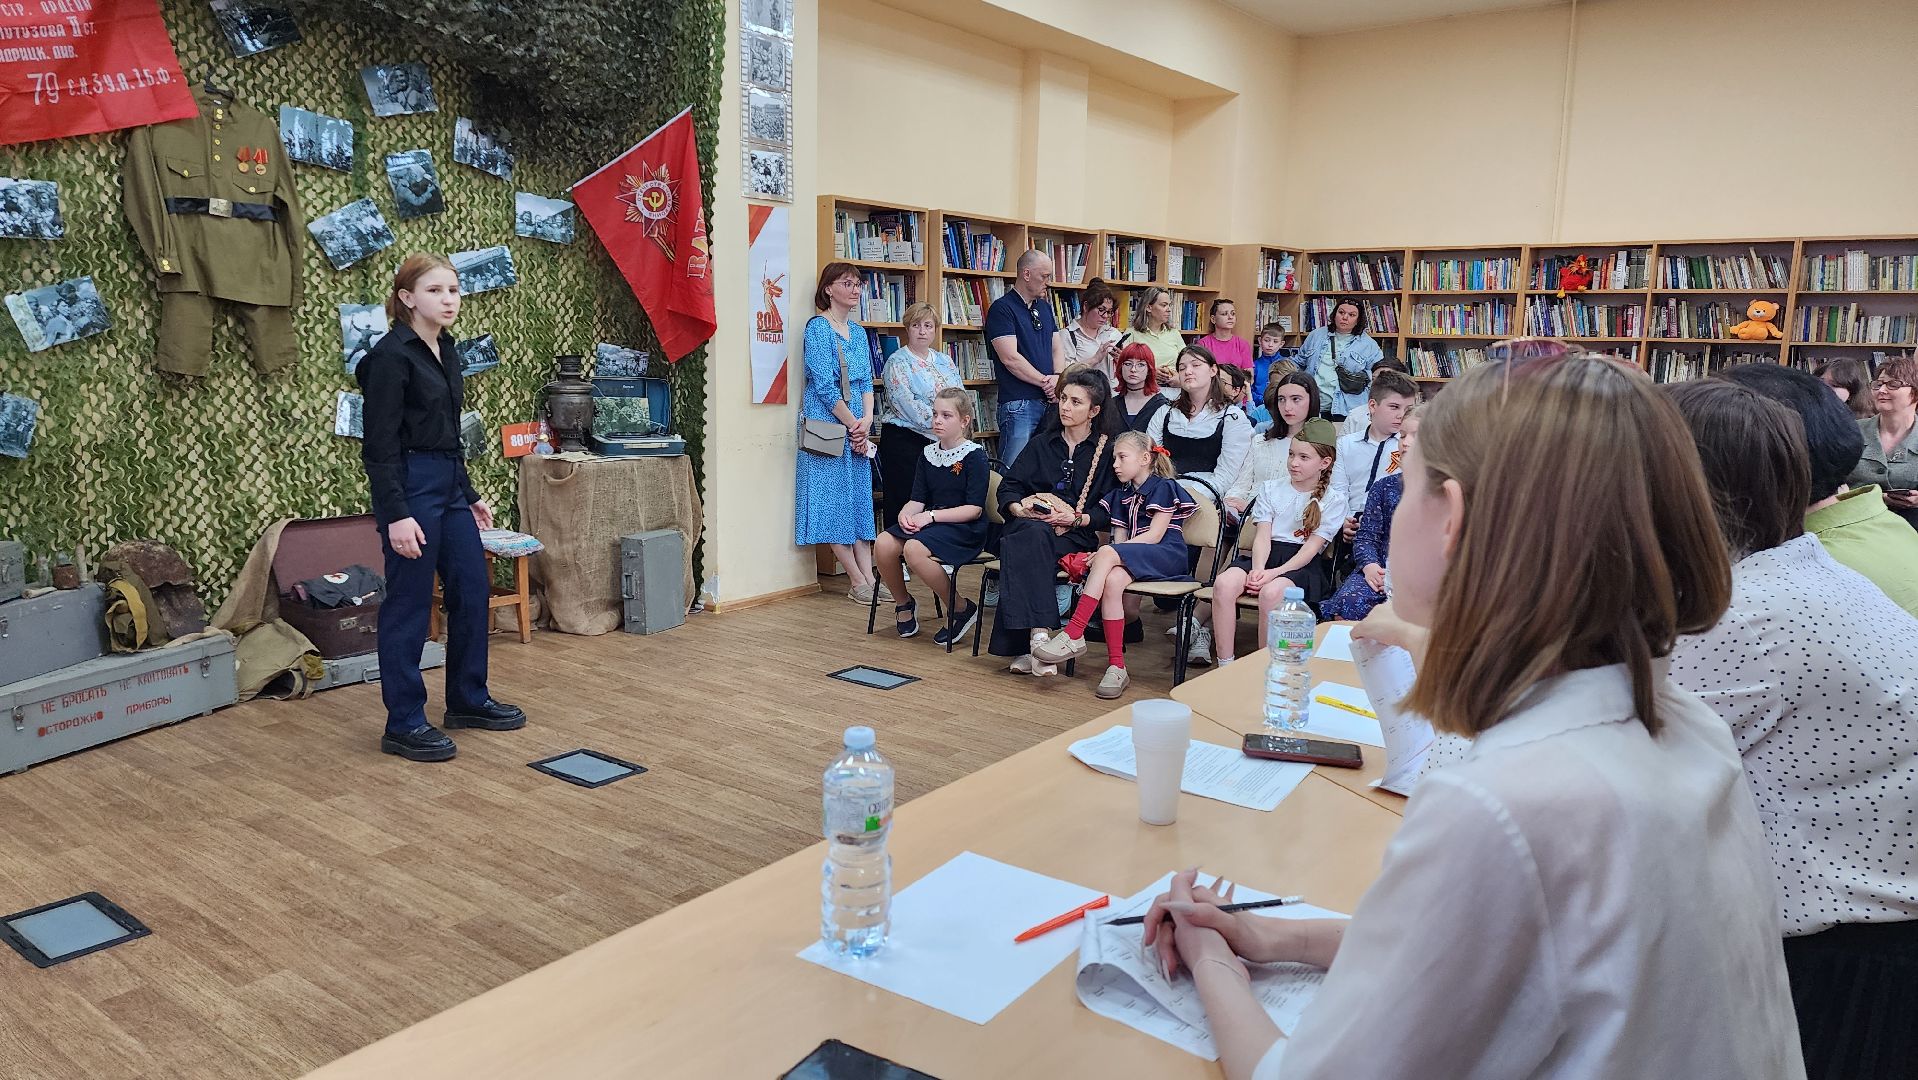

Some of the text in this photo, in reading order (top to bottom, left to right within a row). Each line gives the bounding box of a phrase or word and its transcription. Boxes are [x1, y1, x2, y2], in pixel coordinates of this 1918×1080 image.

[27, 72, 60, 106] 79
[756, 332, 784, 344] ПОБЕДА!
[511, 433, 524, 447] 80
[41, 700, 57, 715] НЕ
[62, 687, 107, 708] БРОСАТЬ
[137, 664, 189, 687] КАНТОВАТЬ
[37, 694, 172, 737] ОСТОРОЖНО ПРИБОРЫ
